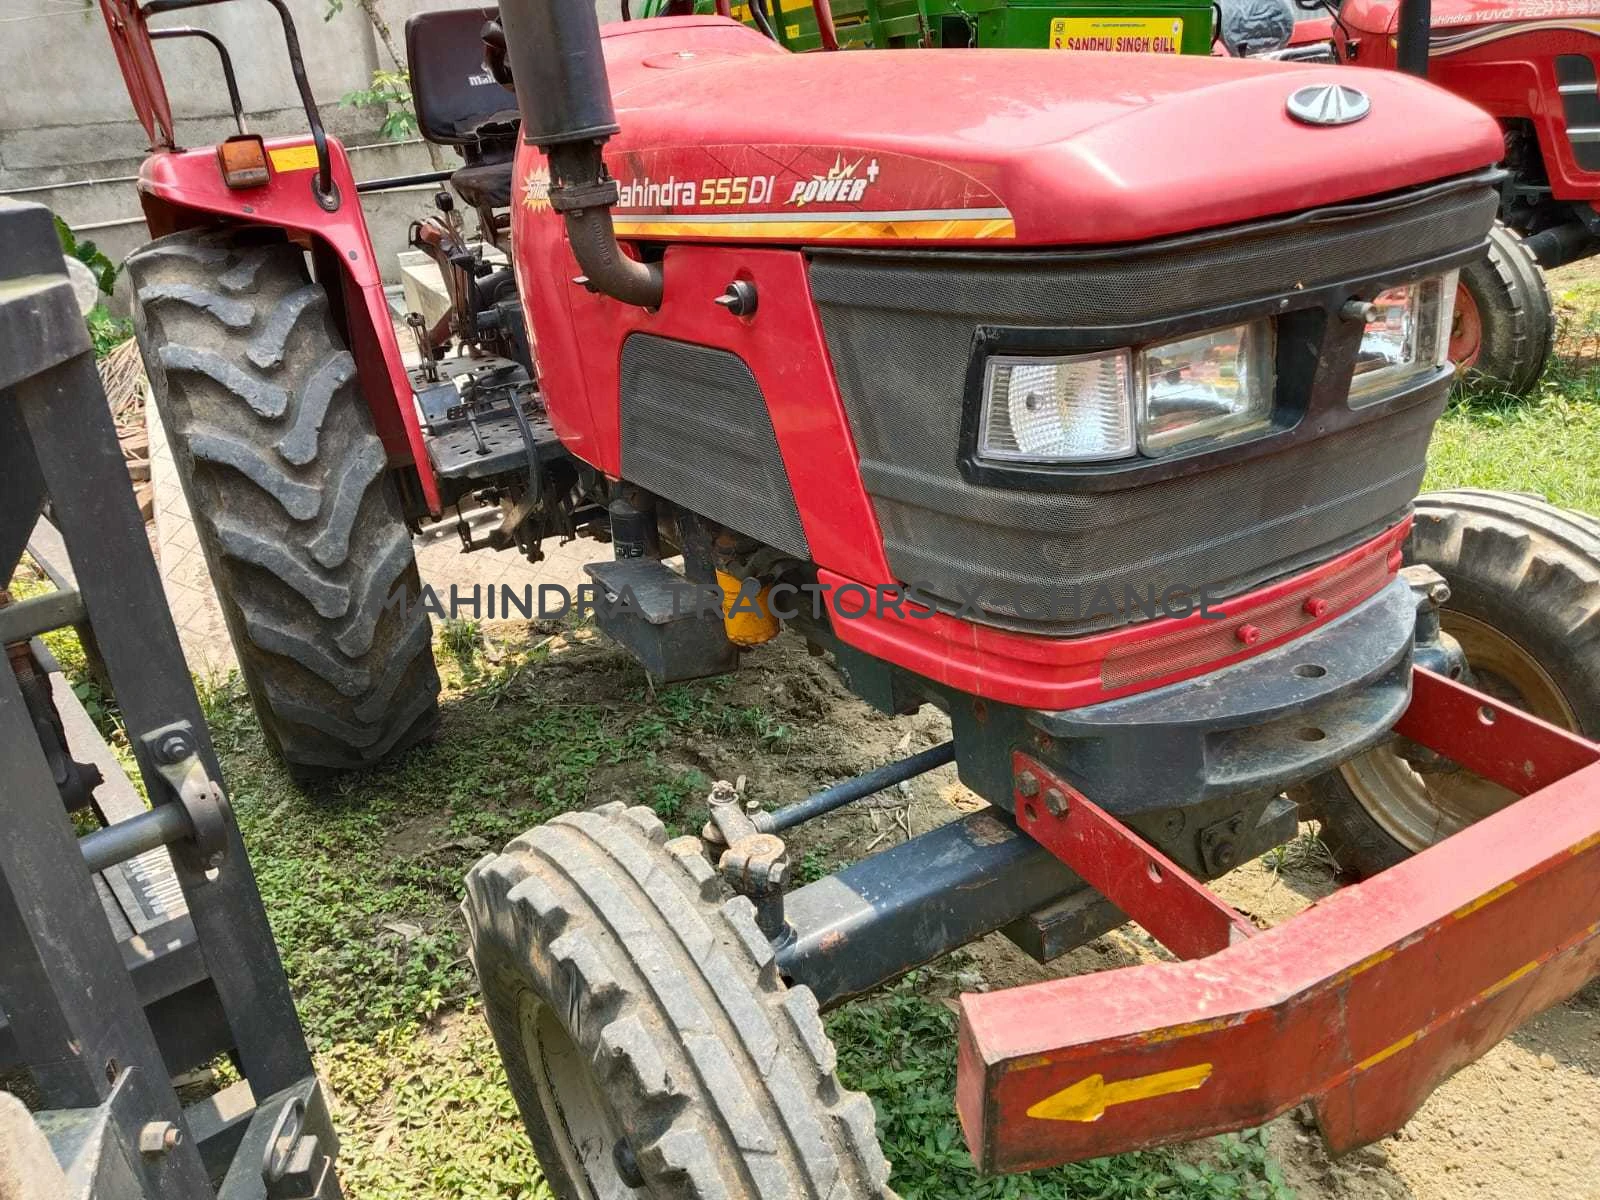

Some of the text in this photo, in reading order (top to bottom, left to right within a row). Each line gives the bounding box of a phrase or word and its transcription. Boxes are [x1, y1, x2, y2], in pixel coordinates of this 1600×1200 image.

[1429, 13, 1472, 25] ahindra
[1475, 8, 1513, 21] YUVO
[1067, 37, 1112, 52] SANDHU
[1115, 37, 1149, 53] SINGH
[1152, 36, 1177, 54] GILL
[615, 176, 695, 208] ahindra
